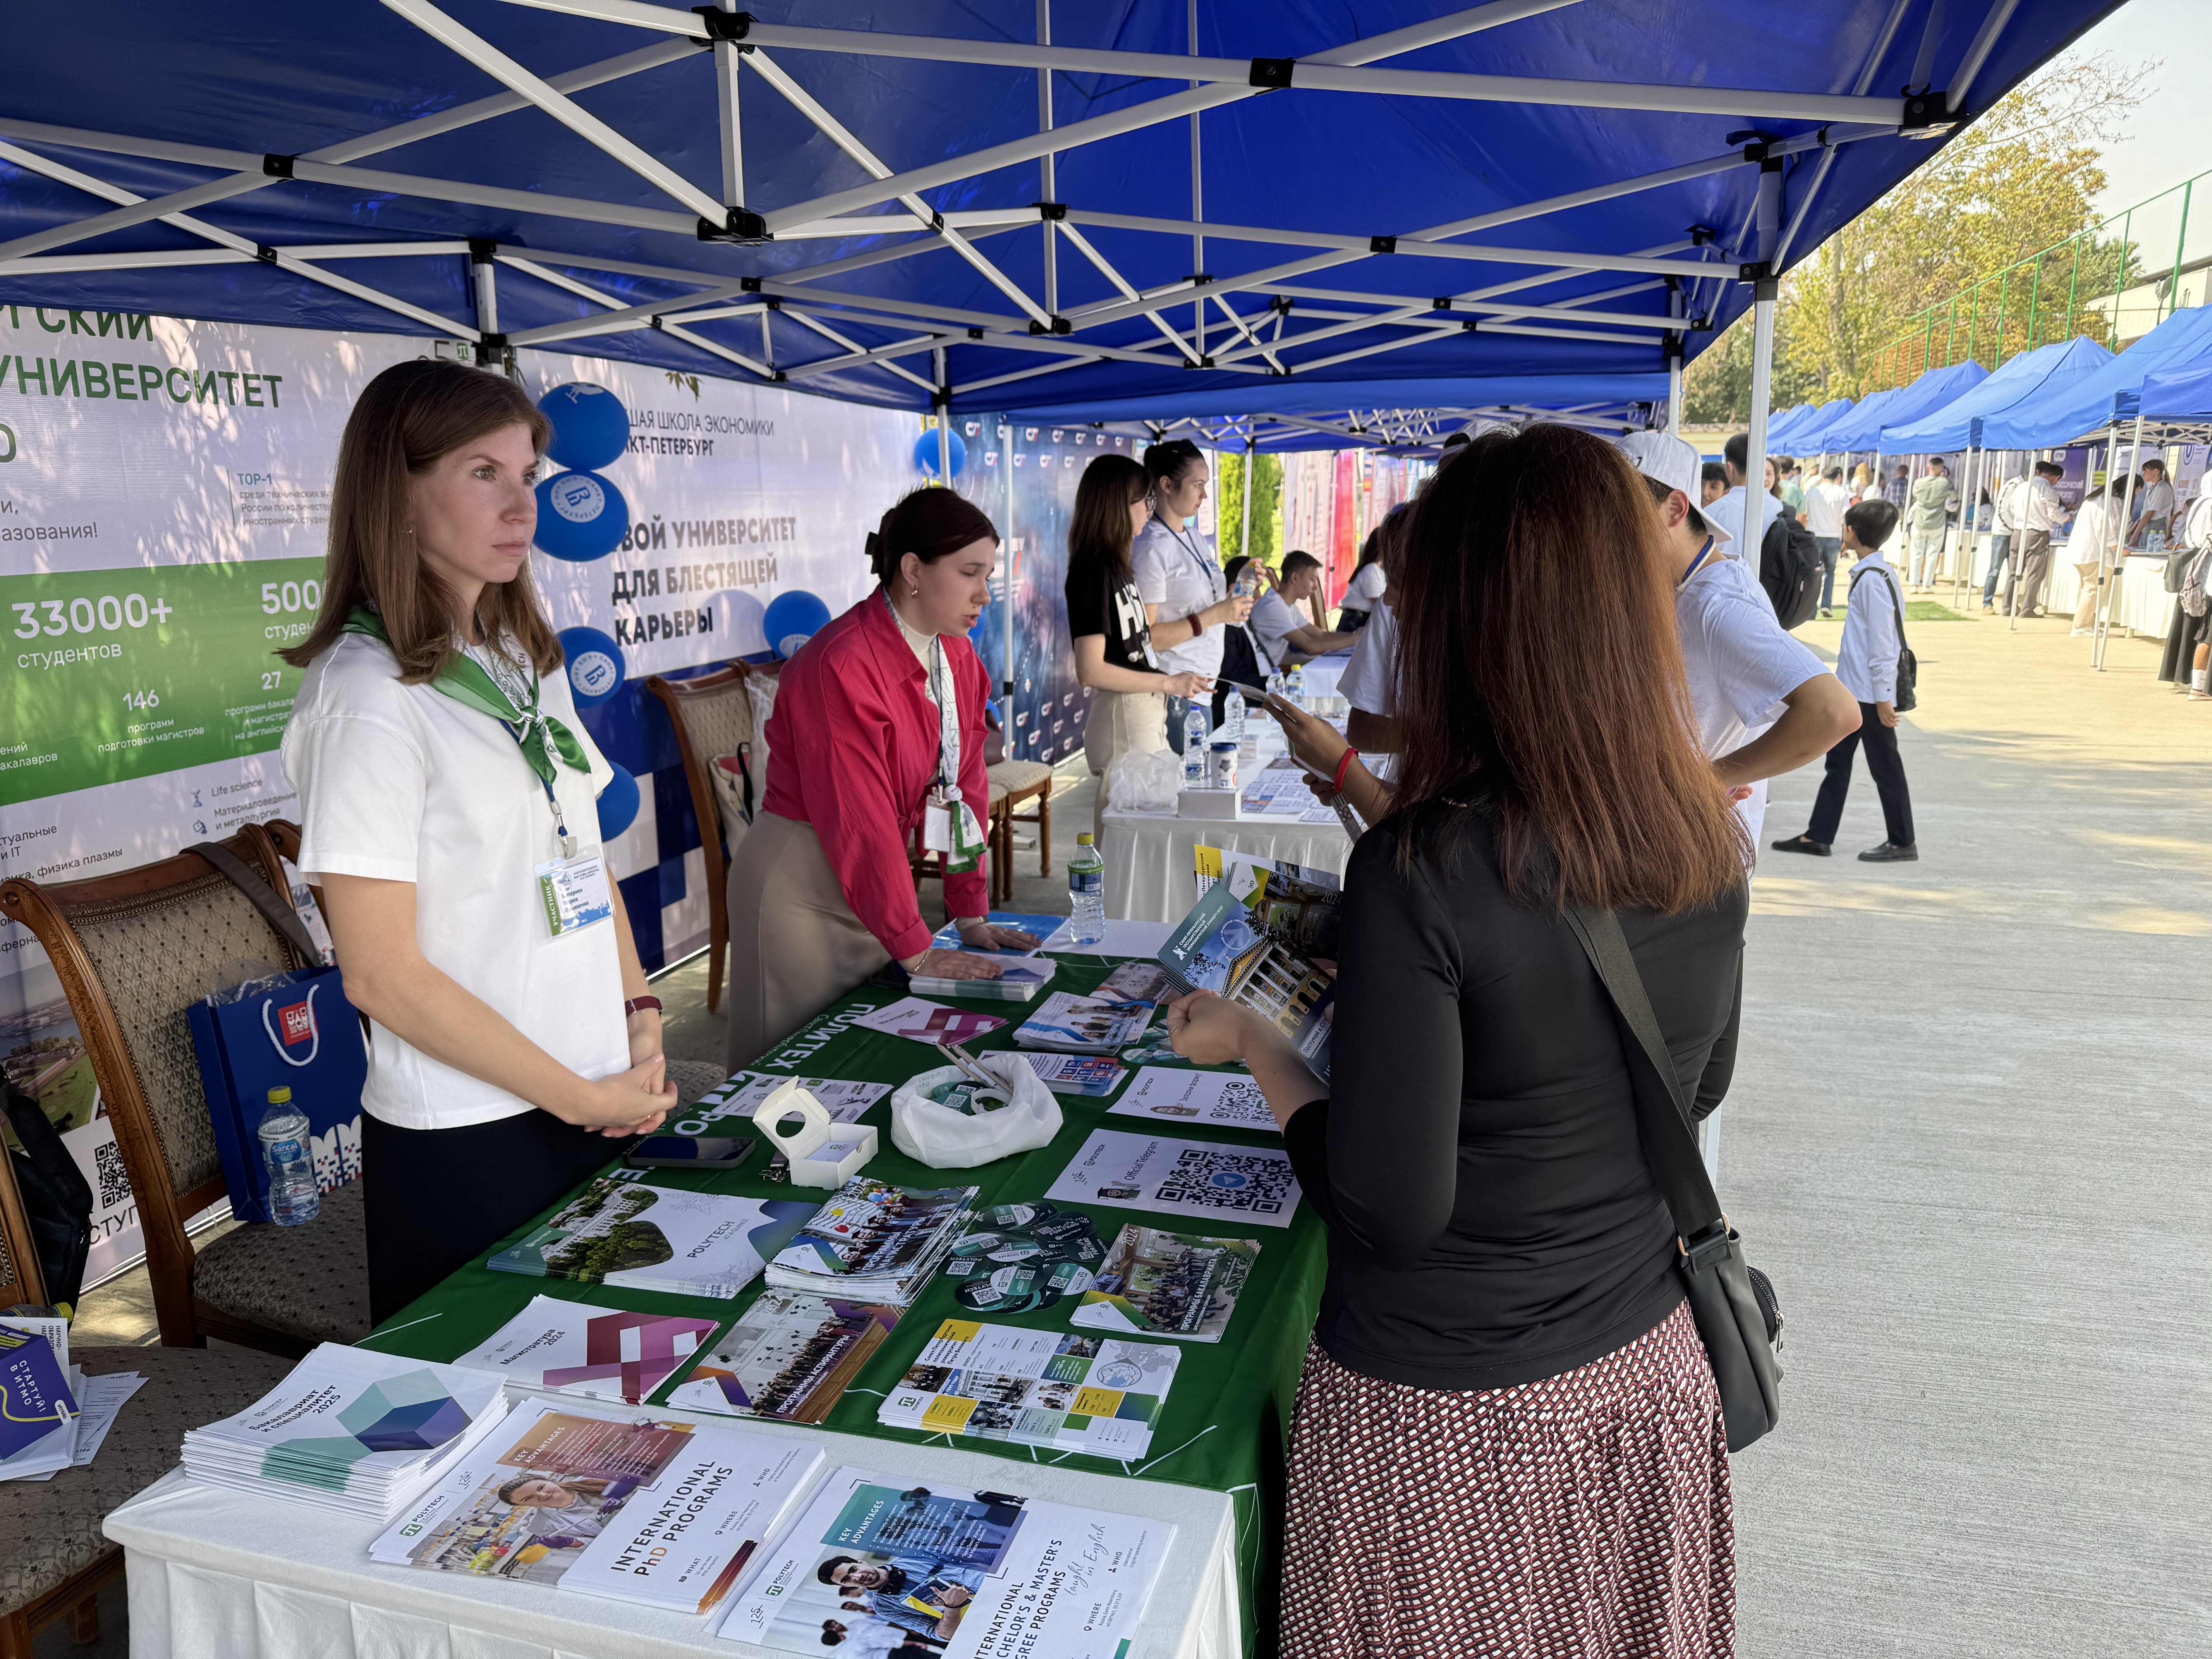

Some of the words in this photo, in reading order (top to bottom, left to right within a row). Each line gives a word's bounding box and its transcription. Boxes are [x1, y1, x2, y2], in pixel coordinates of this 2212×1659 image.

[657, 411, 702, 431] ШКОЛА
[705, 415, 775, 437] ЭКОНОМИКИ
[613, 515, 666, 552] ВОЙ
[672, 517, 797, 550] УНИВЕРСИТЕТ
[611, 568, 660, 606] ДЛЯ
[666, 552, 778, 595] БЛЕСТЯЩЕЙ
[12, 593, 173, 639] 33000+
[615, 607, 714, 647] КАРЬЕРЫ
[18, 644, 122, 670] студентов
[261, 671, 282, 690] 27
[123, 689, 160, 711] 146
[225, 703, 266, 717] программ
[98, 737, 155, 753] подготовки
[156, 726, 205, 742] магистров
[128, 719, 174, 734] программ
[0, 753, 58, 771] акалавров
[211, 785, 228, 797] Life
[230, 778, 263, 793] science
[214, 791, 297, 817] Материаловедение
[223, 807, 280, 828] металлургия
[11, 846, 21, 858] IT
[37, 858, 80, 878] физика
[82, 848, 123, 866] плазмы
[1321, 890, 1343, 907] 2024
[765, 1003, 876, 1069] ПОЛИТЕХ
[1124, 1159, 1144, 1180] Official
[1137, 1140, 1159, 1166] Telegram
[849, 1182, 867, 1199] 2024
[686, 1221, 735, 1259] POLYTECH
[723, 1232, 732, 1241] AT
[733, 1218, 750, 1235] GLANCE
[879, 1216, 926, 1269] МАГИСТРАТУРЫ
[1121, 1228, 1140, 1247] 2024
[861, 1231, 902, 1271] ПРОГРАММЫ
[760, 1294, 786, 1316] 2024
[1180, 1295, 1199, 1331] ПРОГРАММЫ
[1194, 1258, 1218, 1299] БАКАЛАВРИАТА
[499, 1328, 556, 1366] Магистратура
[543, 1330, 566, 1346] 2024
[19, 1360, 46, 1413] СТАРТУЙ!
[776, 1372, 815, 1413] ПРОГРАММЫ
[812, 1334, 850, 1375] АСПИРАНТУРЫ
[14, 1376, 32, 1406] ИТМО
[312, 1394, 341, 1414] 2025
[248, 1389, 319, 1431] Бакалавриат
[271, 1384, 337, 1429] специалитет
[513, 1449, 529, 1462] KEY
[524, 1425, 565, 1463] ADVANTAGES
[757, 1468, 771, 1482] WHO
[412, 1494, 445, 1523] POLYTECH
[610, 1460, 716, 1572] INTERNATIONAL
[633, 1547, 668, 1577] PhD
[662, 1466, 734, 1542] PROGRAMS
[719, 1510, 738, 1530] WHERE
[851, 1500, 884, 1544] ADVANTAGES
[838, 1527, 853, 1542] KEY
[1083, 1522, 1109, 1562] English
[684, 1558, 702, 1575] WHAT
[773, 1559, 795, 1584] POLYTECH
[1086, 1566, 1094, 1577] in
[1111, 1551, 1123, 1565] WHO
[1064, 1561, 1085, 1596] taught
[996, 1605, 1030, 1658] CHELOR'S
[1032, 1539, 1063, 1589] MASTER'S
[974, 1582, 1024, 1659] TERNATIONAL
[1015, 1633, 1037, 1659] GREE
[1029, 1571, 1066, 1630] PROGRAMS
[1087, 1602, 1102, 1624] WHERE
